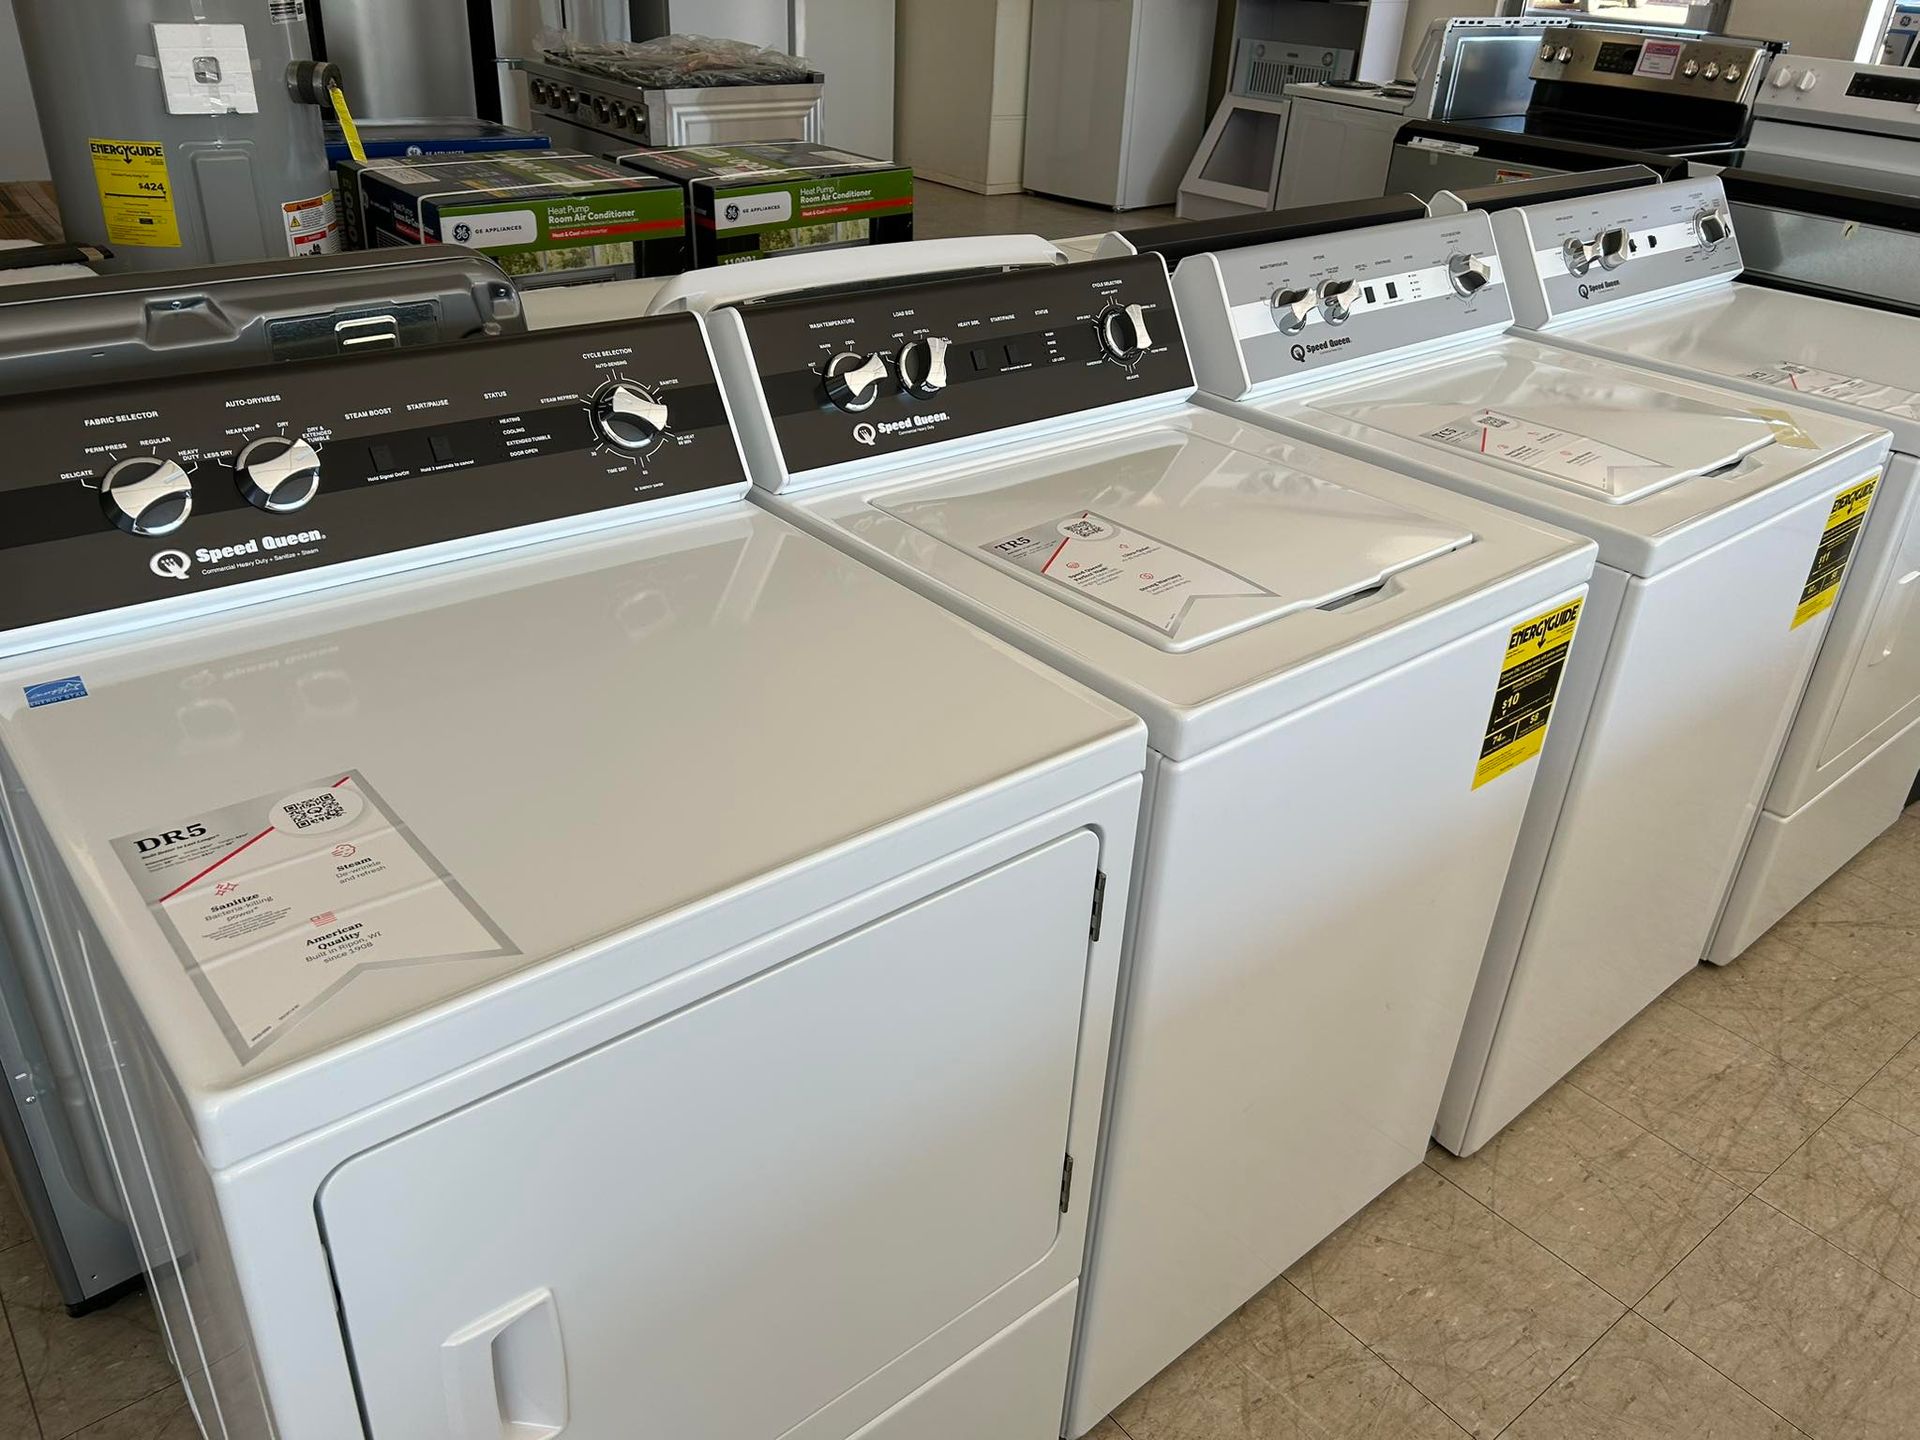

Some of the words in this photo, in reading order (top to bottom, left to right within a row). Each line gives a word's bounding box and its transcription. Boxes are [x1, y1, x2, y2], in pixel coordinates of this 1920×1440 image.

[90, 143, 164, 158] ENERGYGUIDE
[138, 182, 165, 191] $424
[800, 187, 815, 196] Heat
[816, 186, 835, 195] Pump
[800, 195, 820, 204] Room
[821, 194, 832, 202] Air
[832, 189, 872, 200] Conditioner
[548, 206, 567, 216] Heat
[567, 204, 590, 214] Pump
[750, 204, 781, 213] APPLIANCES
[548, 216, 573, 224] Room
[574, 213, 587, 222] Air
[587, 209, 635, 220] Conditioner
[487, 225, 523, 234] APPLIANCES
[1588, 282, 1604, 293] Speed
[892, 310, 904, 318] LOAD
[823, 318, 856, 328] TEMPERATURE
[582, 351, 601, 360] CYCLE
[601, 347, 633, 357] SELECTION
[1306, 340, 1328, 355] Speed
[595, 360, 628, 369] AUTO-SENSING
[225, 394, 282, 408] AUTO-DRYNESS
[483, 390, 508, 400] STATUS
[557, 393, 579, 402] REFRESH
[406, 399, 449, 411] START/PAUSE
[84, 416, 115, 427] FABRIC
[116, 411, 159, 423] SELECTOR
[344, 410, 369, 421] STEAM
[369, 407, 392, 417] BOOST
[499, 416, 521, 424] HEATING
[225, 428, 241, 436] NEAR
[502, 427, 526, 435] COOLING
[877, 418, 913, 434] Speed
[302, 429, 333, 439] EXTENDED
[306, 435, 331, 443] TUMBLE
[506, 437, 532, 446] EXTENDED
[532, 434, 551, 443] TUMBLE
[140, 436, 171, 446] REGULAR
[85, 446, 103, 454] PERM
[103, 442, 128, 452] PRESS
[178, 448, 200, 457] HEAVY
[219, 449, 233, 457] DRY
[509, 449, 525, 457] DOOR
[525, 447, 539, 455] OPEN
[182, 454, 200, 462] DUTY
[60, 469, 94, 480] DELICATE
[379, 473, 395, 481] Signal
[994, 536, 1031, 552] TR5
[195, 539, 259, 564] Speed
[201, 562, 236, 576] Commercial
[237, 560, 255, 570] Heavy
[255, 557, 270, 567] Duty
[274, 552, 297, 561] Sanitize
[301, 547, 319, 556] Steam
[1508, 605, 1580, 651] ENERGYGUIDE
[30, 696, 63, 707] ENERGY
[64, 691, 87, 701] STAR
[1501, 693, 1520, 710] $10
[134, 823, 207, 853] DR5
[336, 856, 372, 872] Steam
[336, 861, 382, 879] De-wrinkle
[339, 873, 356, 885] and
[355, 864, 387, 880] refresh
[204, 896, 274, 922] Bacteria-killing
[210, 892, 260, 914] Sanitize
[305, 921, 364, 947] American
[305, 950, 328, 963] Built
[328, 946, 338, 956] in
[338, 936, 368, 953] Ripon,
[367, 930, 383, 942] WI
[317, 931, 361, 952] Quality
[323, 951, 348, 965] since
[348, 941, 374, 956] 1908
